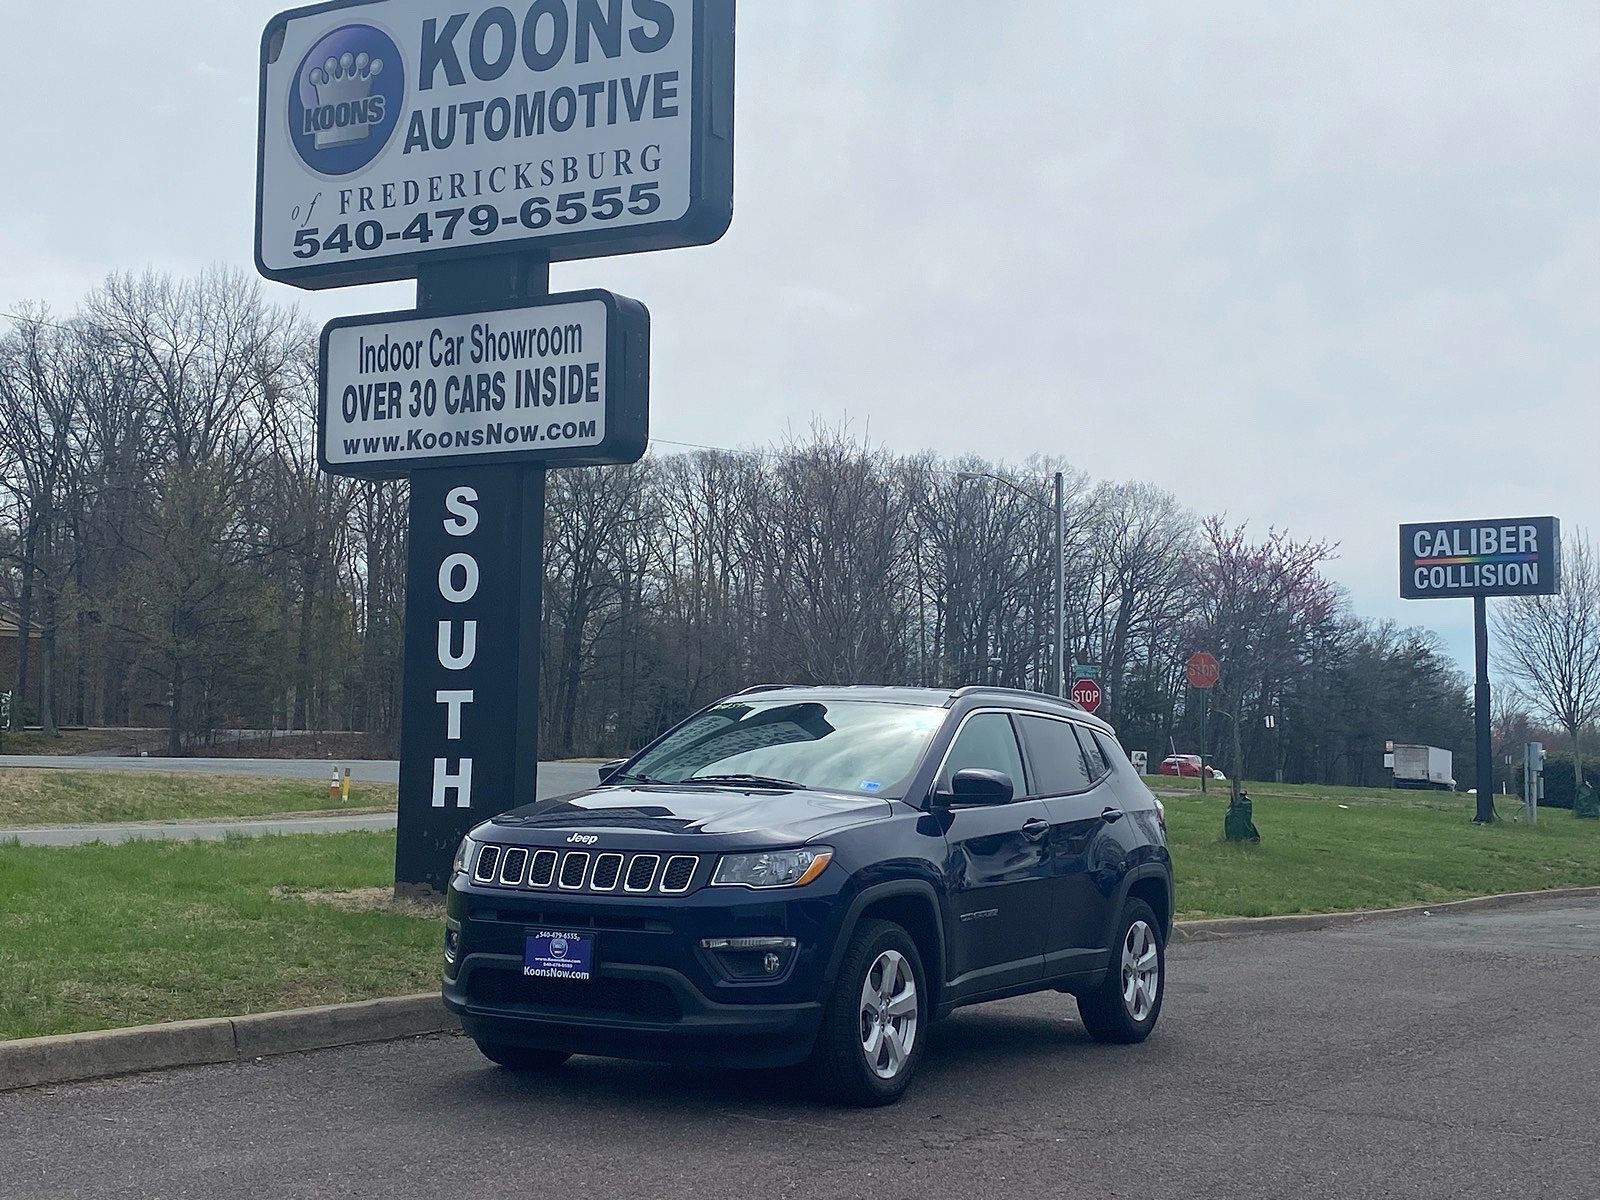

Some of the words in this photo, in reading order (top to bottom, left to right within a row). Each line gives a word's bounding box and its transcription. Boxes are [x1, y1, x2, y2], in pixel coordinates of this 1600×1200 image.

[418, 0, 676, 91] KOONS
[304, 96, 384, 133] KOONS
[403, 71, 679, 154] AUTOMOTIVE
[291, 192, 322, 227] of
[339, 144, 662, 215] FREDERICKSBURG
[293, 182, 661, 259] 540-479-6555
[359, 334, 423, 374] Indoor
[429, 328, 464, 368] Car
[470, 323, 583, 364] Showroom
[342, 381, 402, 424] OVER
[408, 378, 436, 418] 30
[444, 371, 506, 415] CARS
[515, 363, 600, 409] INSIDE
[1413, 525, 1538, 558] CALIBER
[1413, 562, 1539, 589] COLLISION
[431, 486, 480, 808] SOUTH
[1073, 690, 1099, 703] STOP
[566, 832, 599, 845] Jeep
